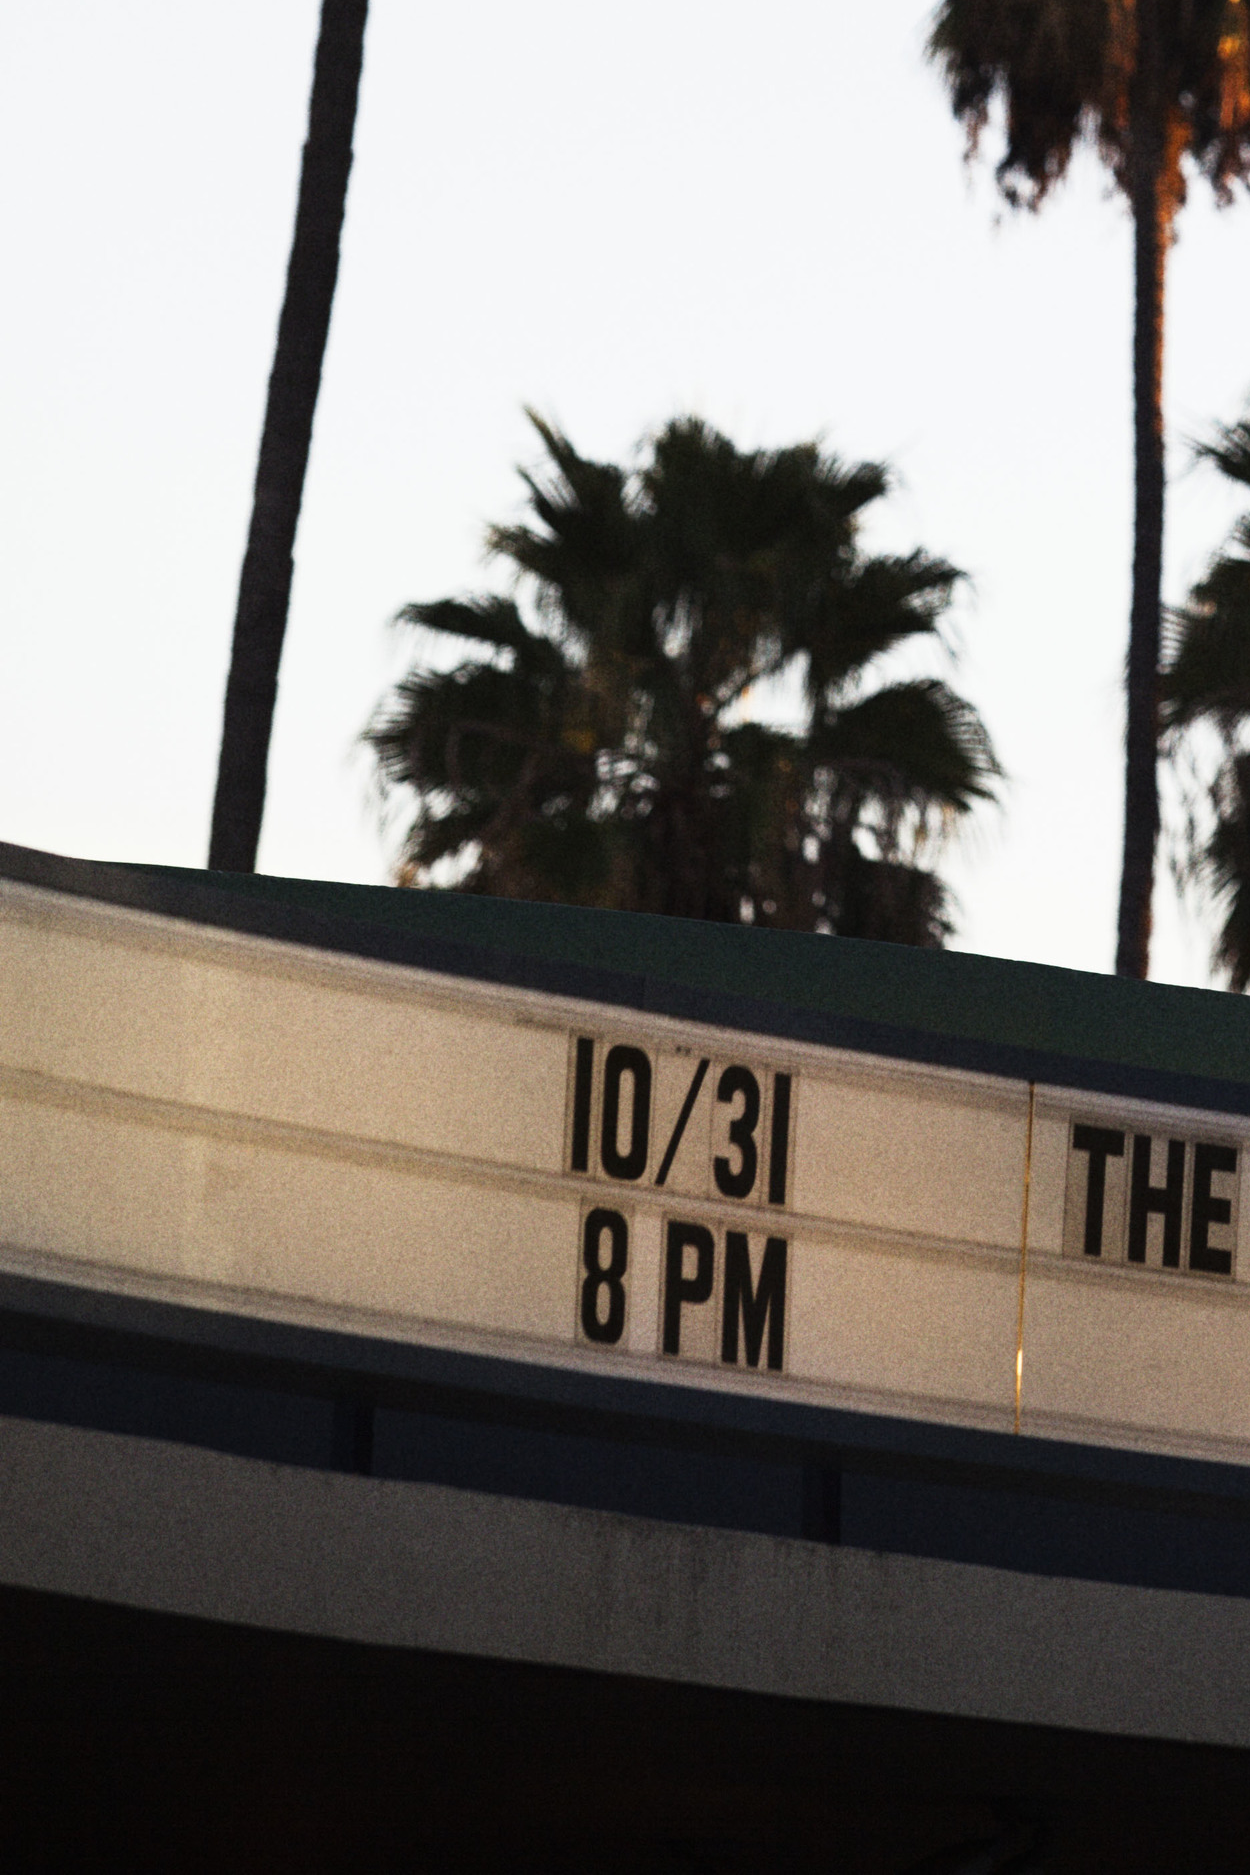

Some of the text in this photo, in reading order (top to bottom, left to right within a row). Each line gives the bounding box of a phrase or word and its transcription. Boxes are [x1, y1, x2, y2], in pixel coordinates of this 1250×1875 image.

[571, 1037, 792, 1205] 10/31
[1073, 1124, 1237, 1275] THE
[580, 1207, 789, 1371] 8 PM
